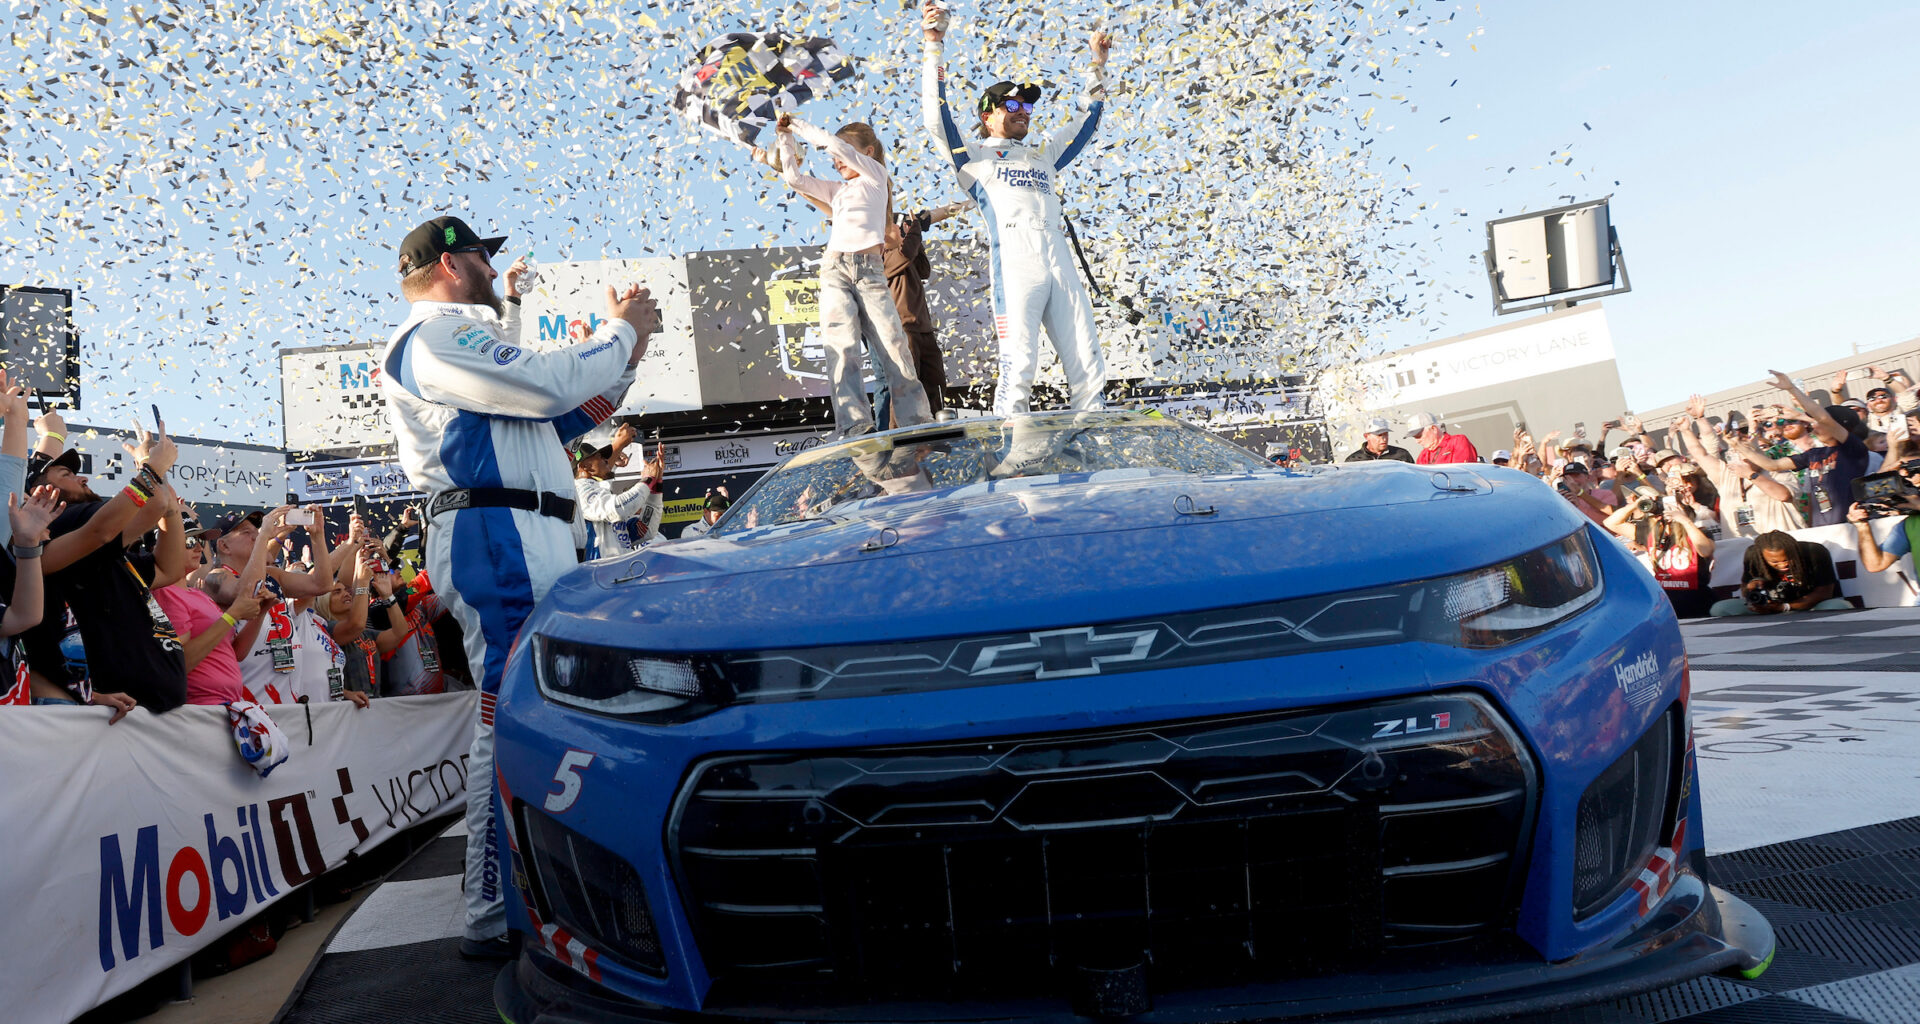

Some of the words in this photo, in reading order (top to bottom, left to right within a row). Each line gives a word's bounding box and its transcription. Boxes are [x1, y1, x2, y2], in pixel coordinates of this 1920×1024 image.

[997, 167, 1049, 182] Hendrick
[1449, 344, 1531, 375] VICTORY
[1537, 330, 1592, 355] LANE
[715, 448, 749, 460] BUSCH
[225, 468, 272, 488] LANE
[663, 503, 705, 514] YellaWo
[265, 602, 293, 644] 5
[1613, 649, 1659, 694] Hendrick
[1372, 711, 1450, 739] ZL1
[543, 748, 597, 814] 5
[99, 803, 280, 973] Mobil
[272, 796, 321, 883] 1
[371, 753, 469, 829] VICTO
